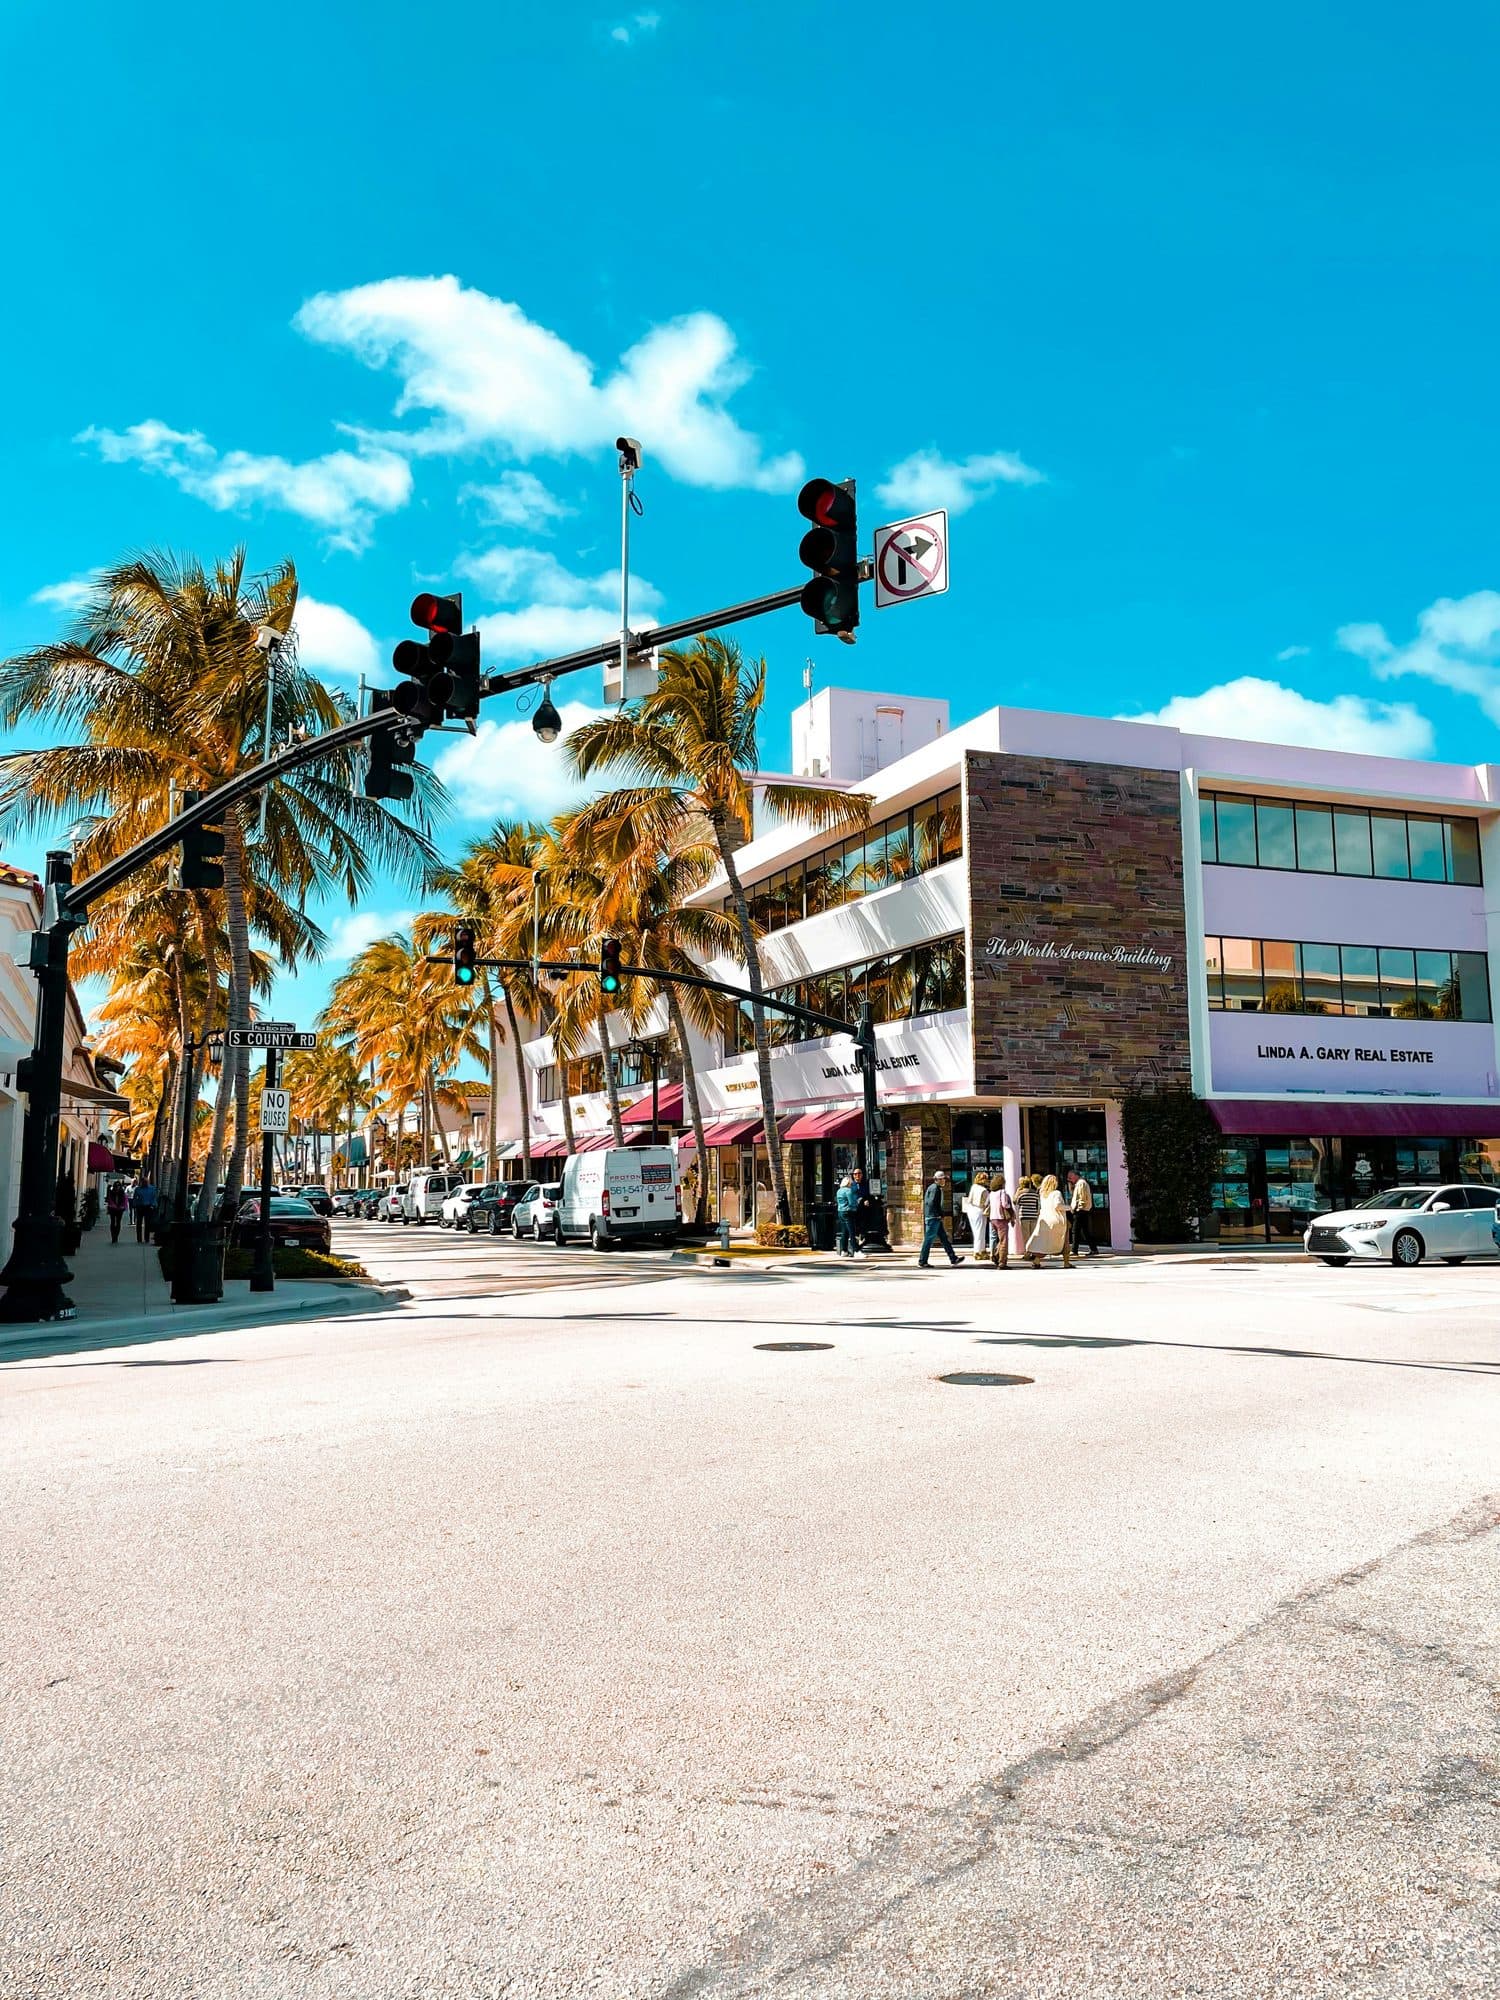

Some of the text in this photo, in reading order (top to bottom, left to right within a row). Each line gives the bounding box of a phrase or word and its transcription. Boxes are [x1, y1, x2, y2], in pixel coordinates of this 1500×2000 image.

[233, 1032, 315, 1047] S COUNTY RD
[1257, 1045, 1434, 1063] LINDA A. GARY REAL ESTATE
[851, 1063, 864, 1074] GA
[890, 1055, 920, 1069] ESTATE
[267, 1093, 285, 1108] NO
[264, 1111, 286, 1126] BUSES
